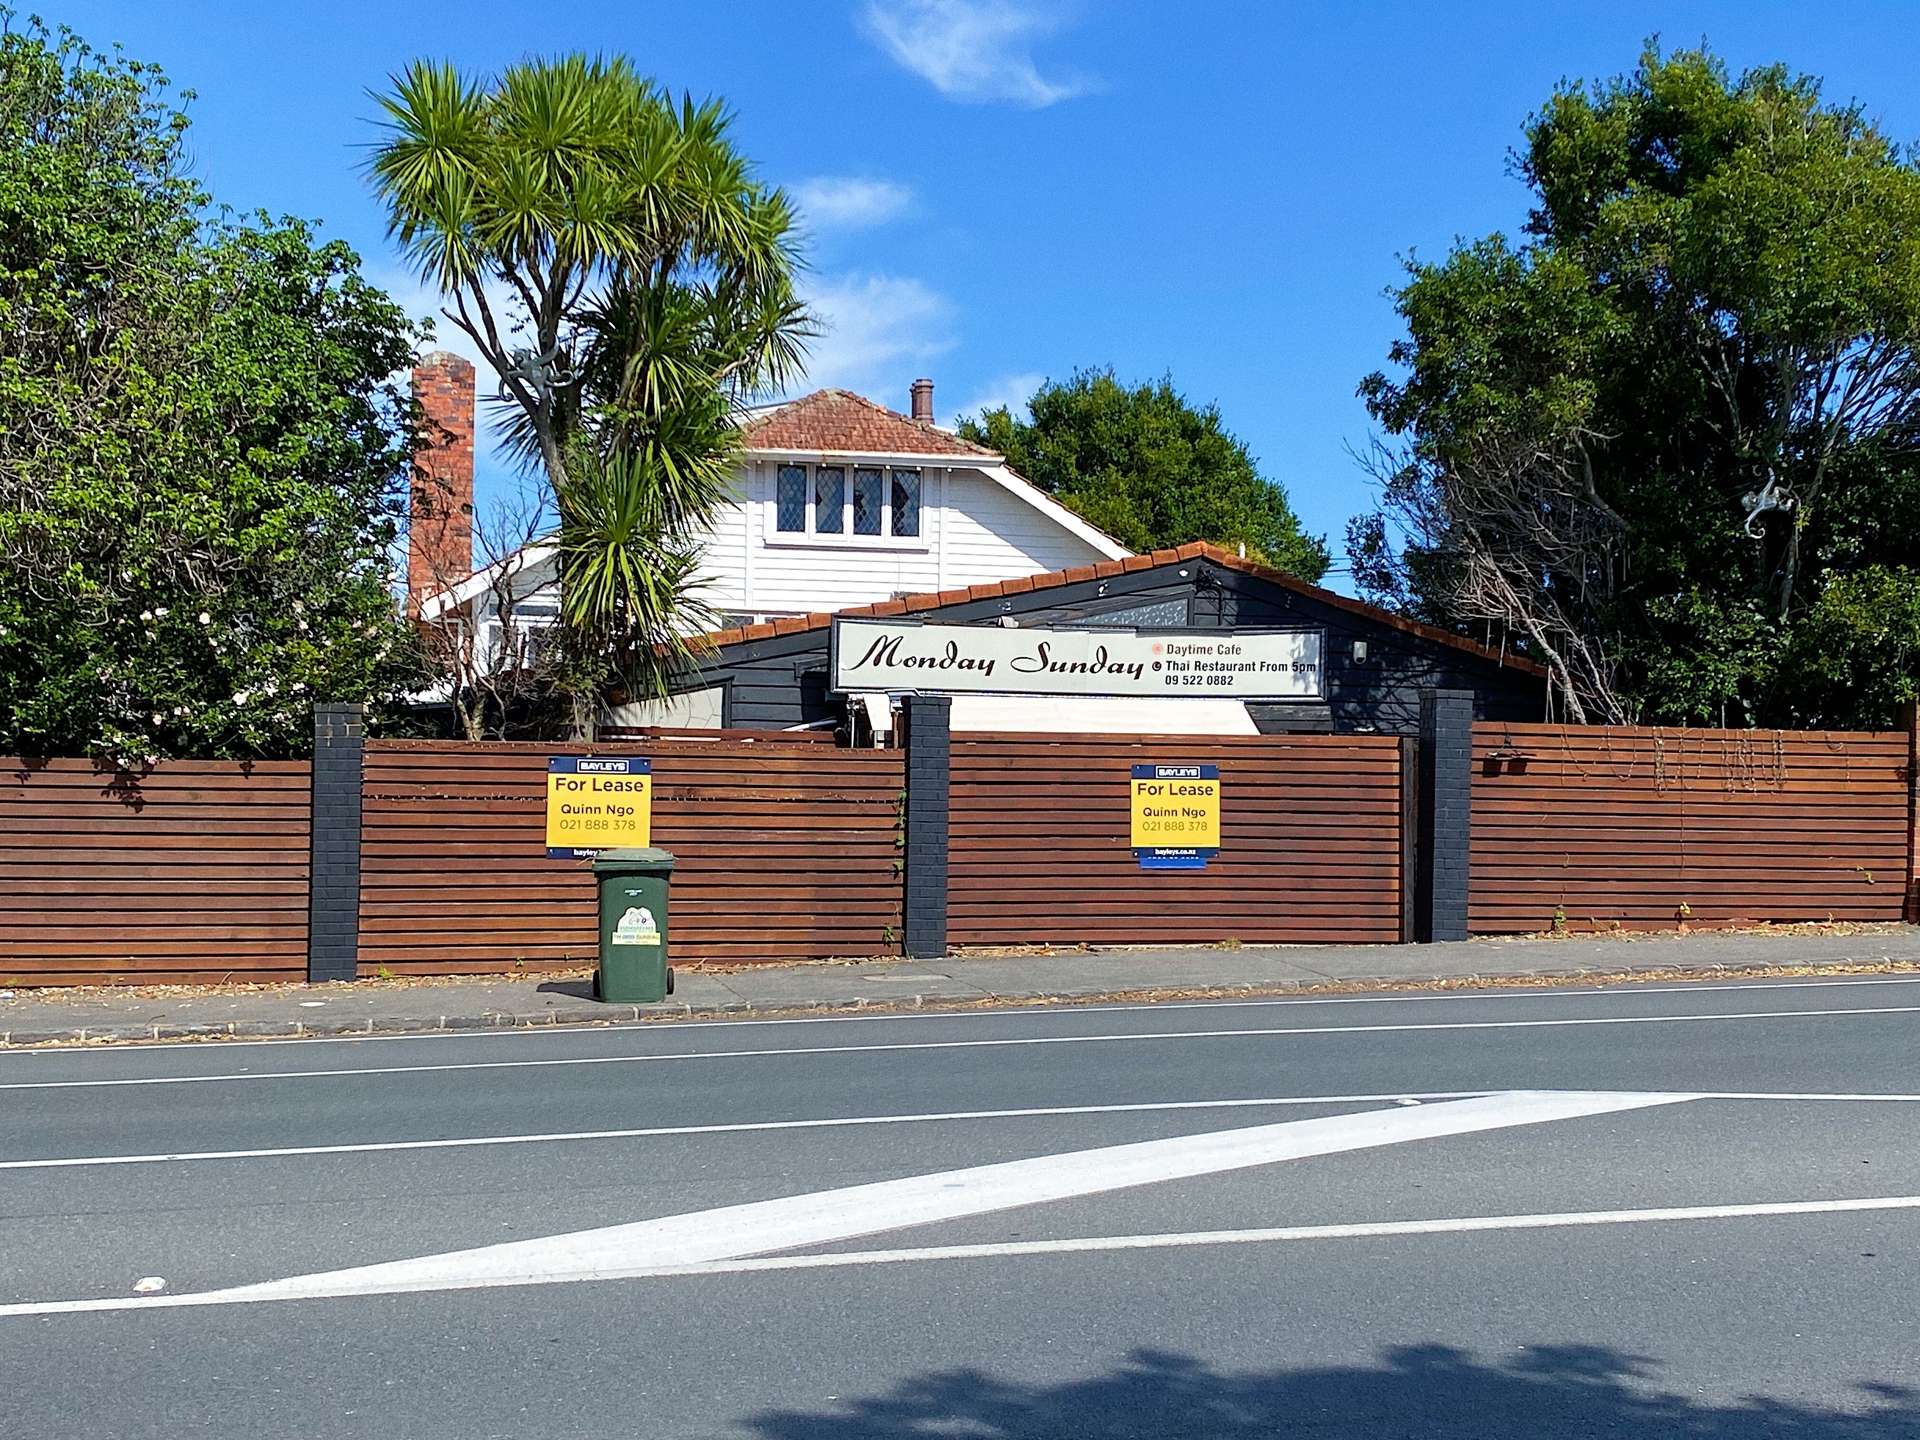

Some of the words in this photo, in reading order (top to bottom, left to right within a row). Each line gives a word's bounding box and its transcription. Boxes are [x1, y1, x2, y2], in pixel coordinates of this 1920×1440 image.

[1166, 643, 1214, 656] Daytime
[841, 634, 995, 676] Monday
[1010, 641, 1144, 680] Sunday
[1166, 660, 1190, 672] Thai
[1194, 661, 1256, 672] Restaurant
[1260, 661, 1288, 672] From
[1291, 661, 1316, 674] 5pm
[1165, 675, 1179, 685] 09
[1182, 675, 1203, 686] 522
[1206, 675, 1234, 686] 0882
[580, 762, 626, 771] BAYLEYS
[1158, 768, 1198, 776] BAYLEYS
[555, 777, 587, 792] For
[592, 777, 644, 792] Lease
[1137, 783, 1164, 796] For
[1169, 783, 1214, 796] Lease
[561, 804, 602, 815] Quinn
[606, 804, 634, 817] Ngo
[1143, 807, 1178, 817] Quinn
[1182, 807, 1206, 819] Ngo
[560, 820, 581, 830] 021
[585, 820, 609, 830] 888
[613, 820, 636, 831] 378
[1142, 821, 1161, 832] 021
[1164, 821, 1185, 832] 888
[1188, 821, 1208, 832] 378
